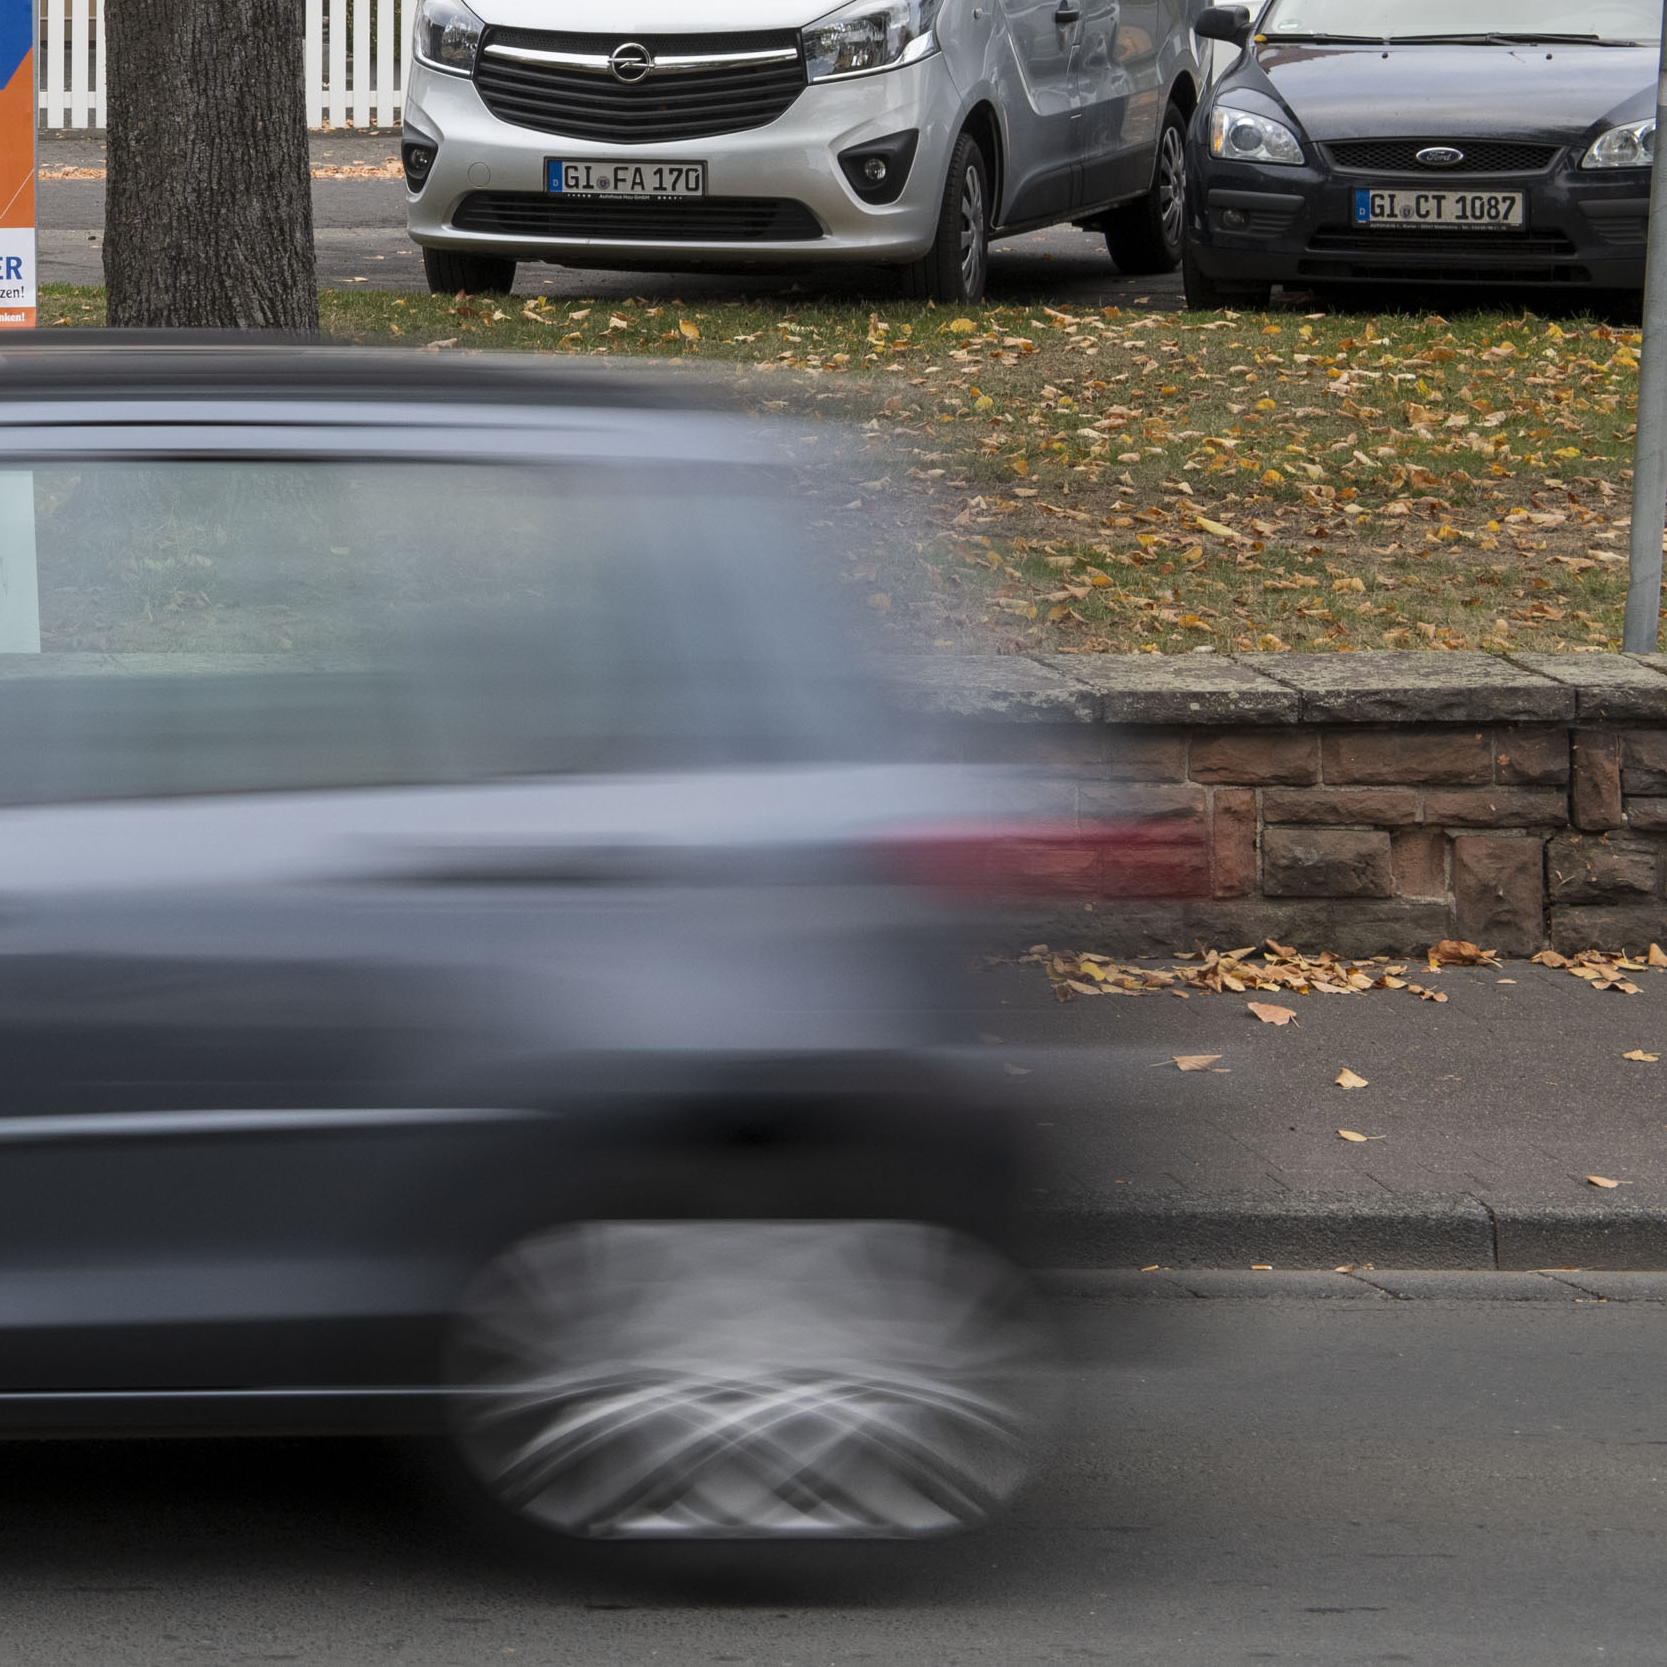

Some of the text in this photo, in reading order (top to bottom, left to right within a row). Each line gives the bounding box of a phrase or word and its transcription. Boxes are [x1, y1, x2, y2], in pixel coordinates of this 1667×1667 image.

[564, 166, 700, 191] GI FA 170
[1370, 194, 1516, 220] GI CT 1087
